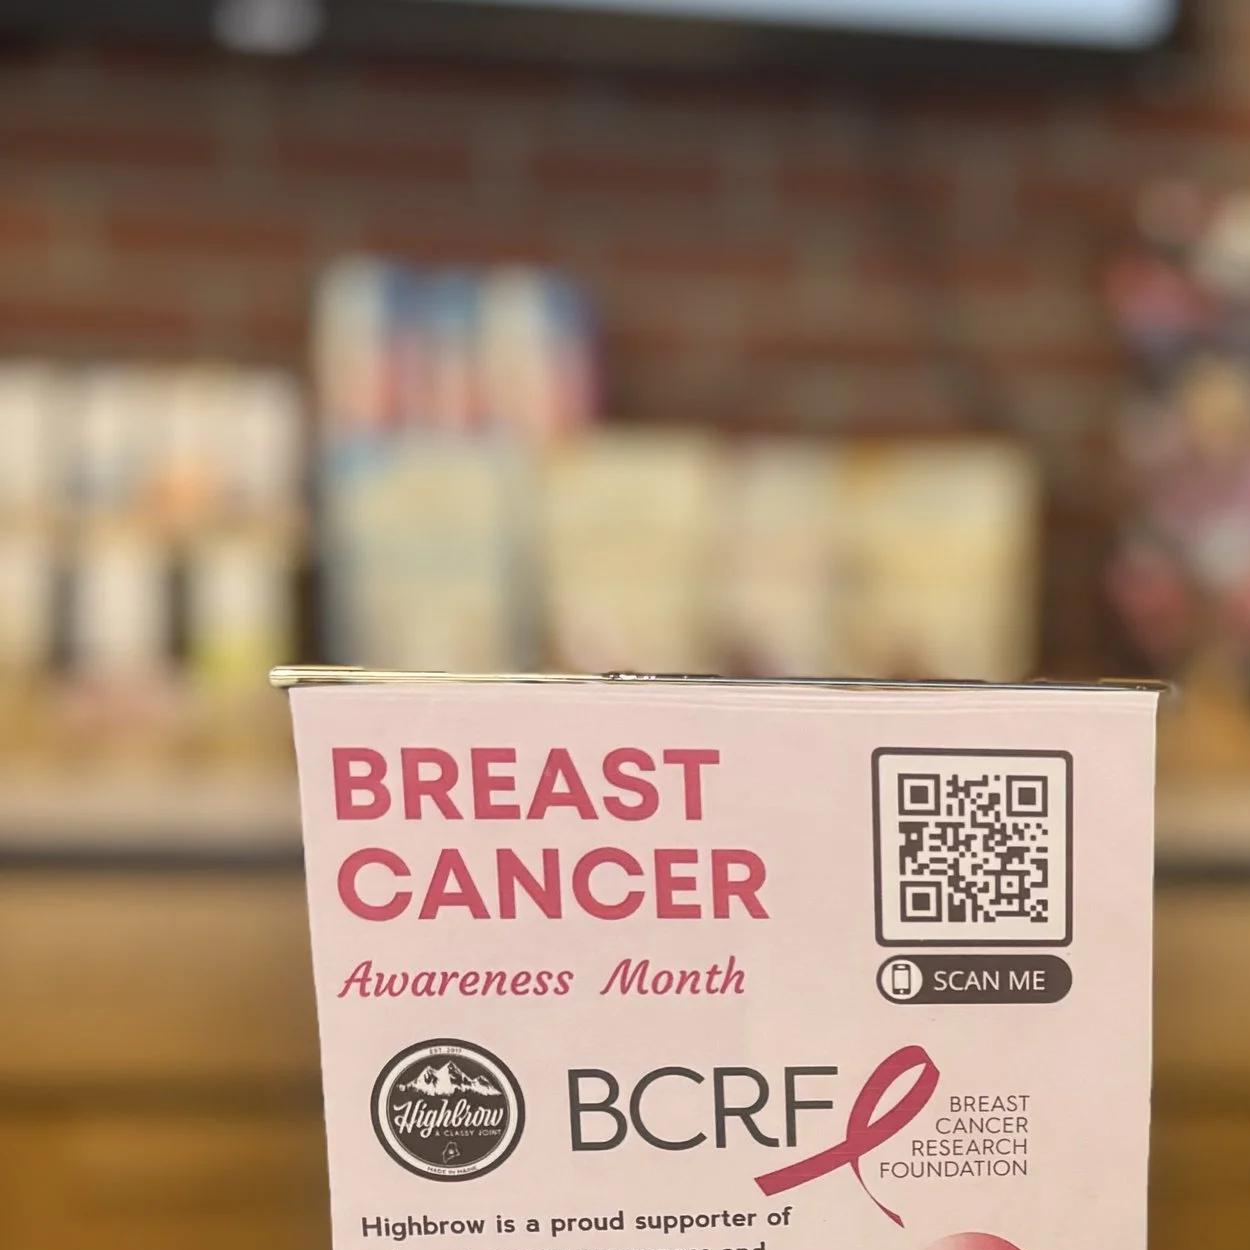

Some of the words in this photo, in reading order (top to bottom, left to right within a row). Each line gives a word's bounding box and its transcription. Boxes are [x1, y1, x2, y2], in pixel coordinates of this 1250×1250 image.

[332, 748, 720, 821] BREAST
[338, 847, 769, 921] CANCER
[338, 960, 574, 998] Awareness
[600, 956, 744, 995] Month
[934, 971, 999, 990] SCAN
[1010, 971, 1045, 990] ME
[568, 1066, 838, 1151] BCRF
[950, 1095, 1030, 1112] BREAST
[393, 1099, 504, 1139] Highbrow
[936, 1117, 1028, 1134] CANCER
[478, 1129, 502, 1137] JOINT
[912, 1138, 1027, 1156] RESEARCH
[880, 1160, 1027, 1178] FOUNDATION
[362, 1215, 485, 1241] Highbrow
[497, 1215, 515, 1233] is
[527, 1219, 539, 1232] a
[551, 1211, 624, 1237] proud
[636, 1211, 757, 1234] supporter
[767, 1206, 792, 1225] of
